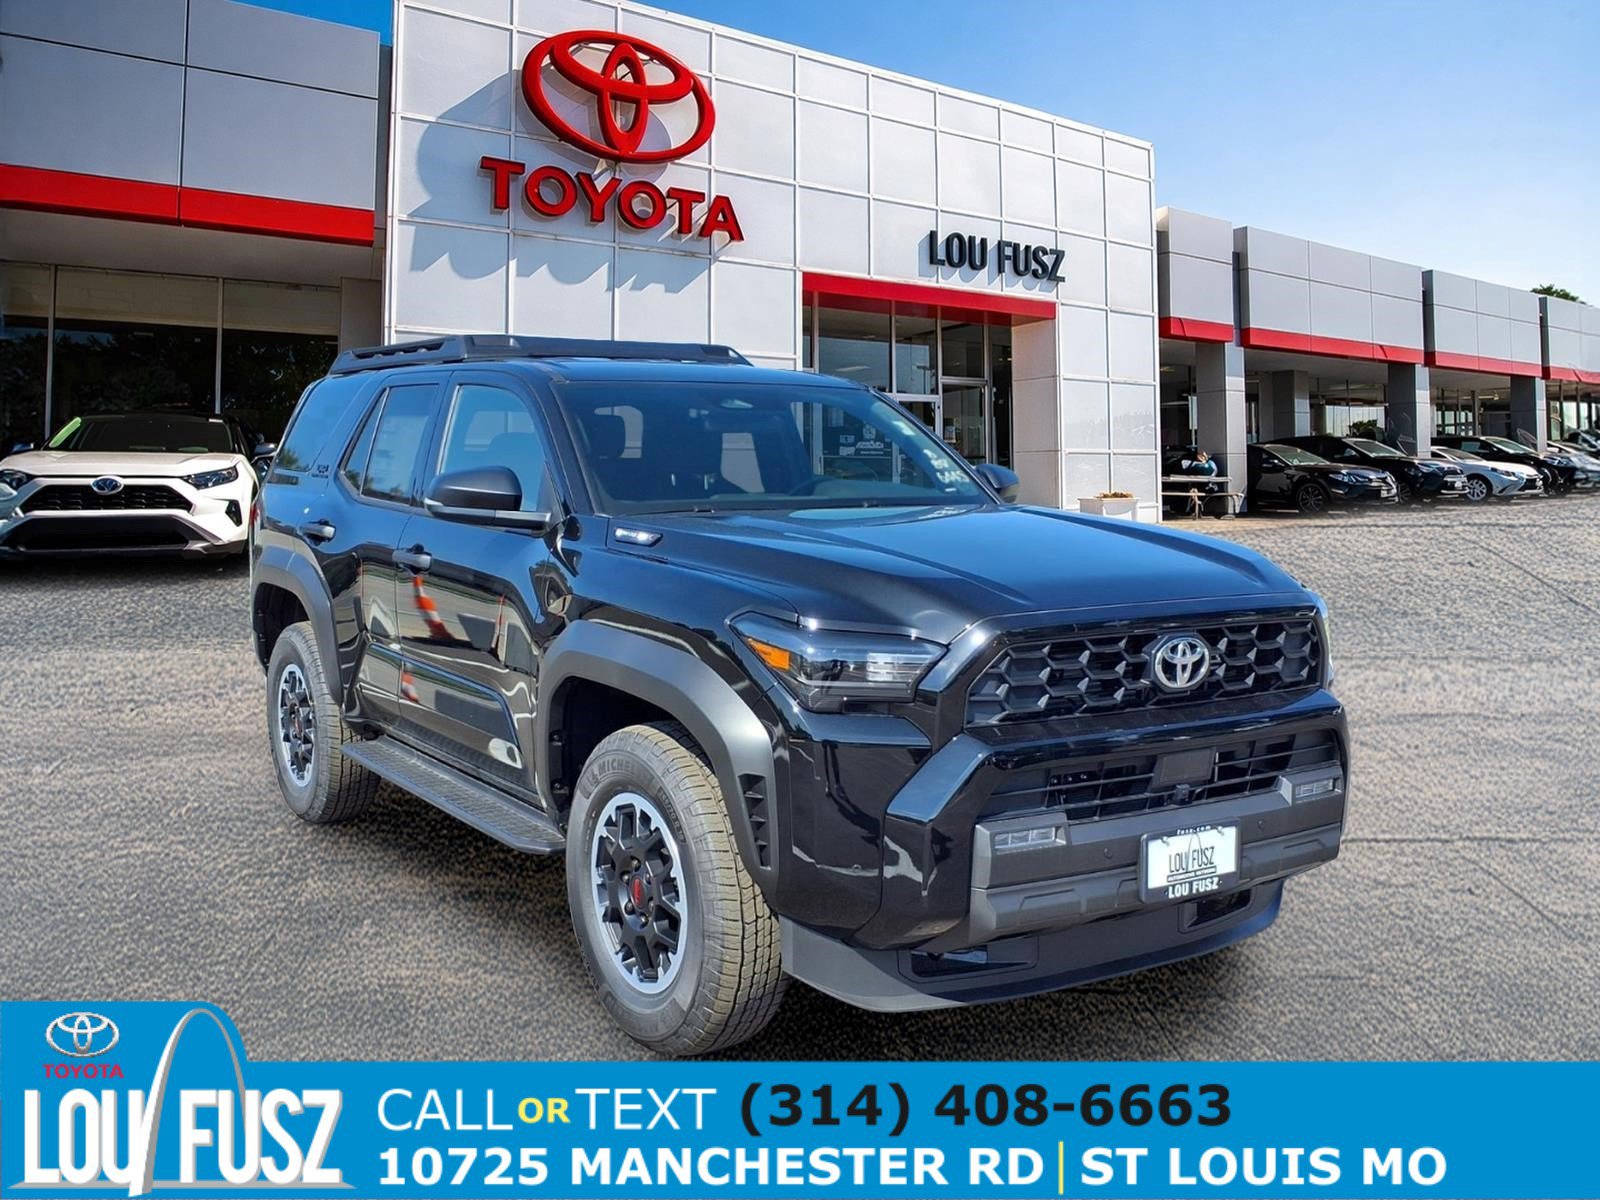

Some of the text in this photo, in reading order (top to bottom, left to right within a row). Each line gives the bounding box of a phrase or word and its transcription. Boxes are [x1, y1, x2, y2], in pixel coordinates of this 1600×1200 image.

[480, 156, 744, 241] TOYOTA
[929, 230, 1066, 283] LOU FUSZ
[1169, 846, 1215, 873] LOU FUSZ
[1168, 877, 1220, 899] LOU FUSZ
